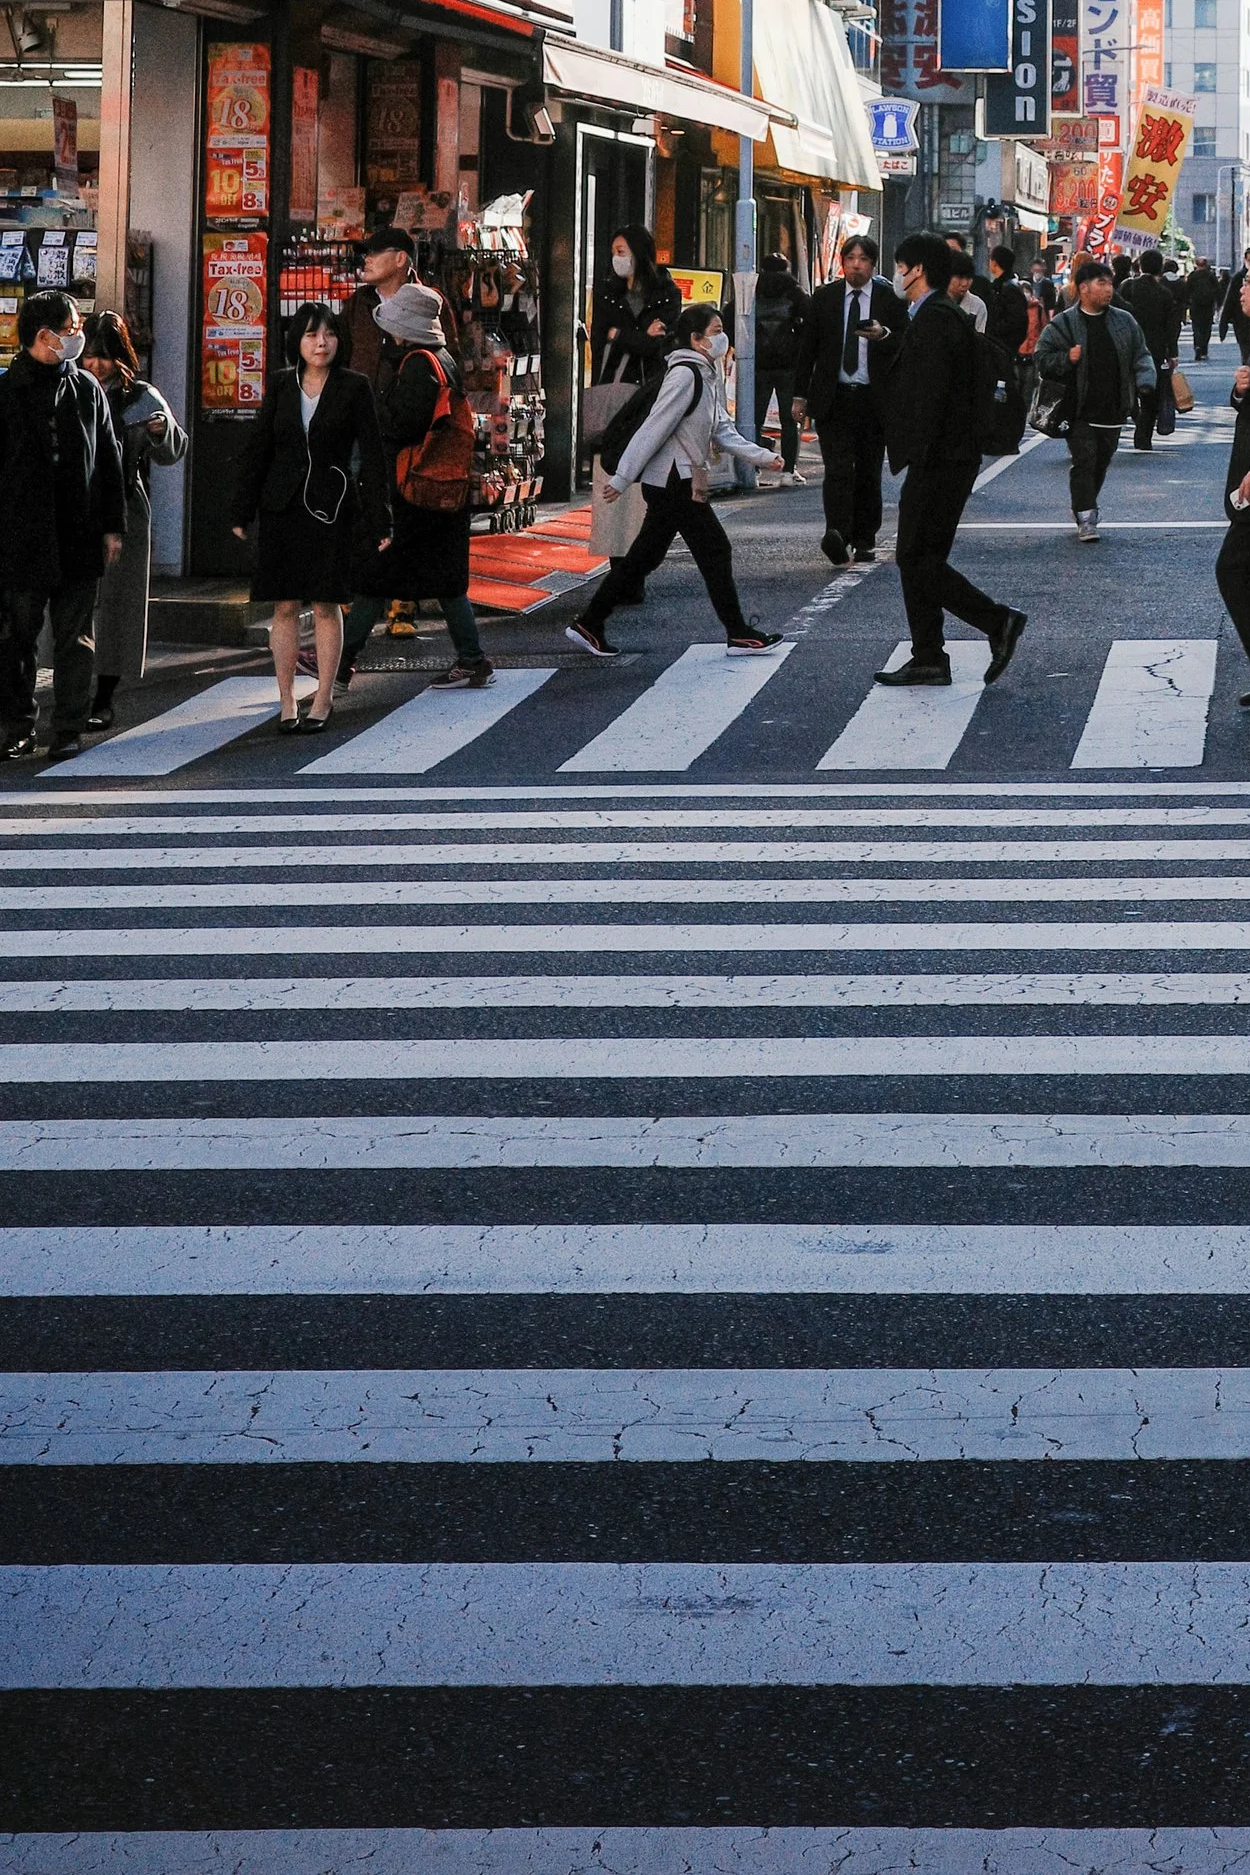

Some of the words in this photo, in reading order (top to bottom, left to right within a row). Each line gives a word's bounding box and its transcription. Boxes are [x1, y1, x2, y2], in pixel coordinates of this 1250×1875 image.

[872, 104, 910, 114] LAWSON
[882, 160, 909, 170] たばこ
[1122, 113, 1184, 221] 激安
[209, 263, 262, 275] Tax-free
[702, 280, 714, 295] 金
[211, 287, 248, 321] 18
